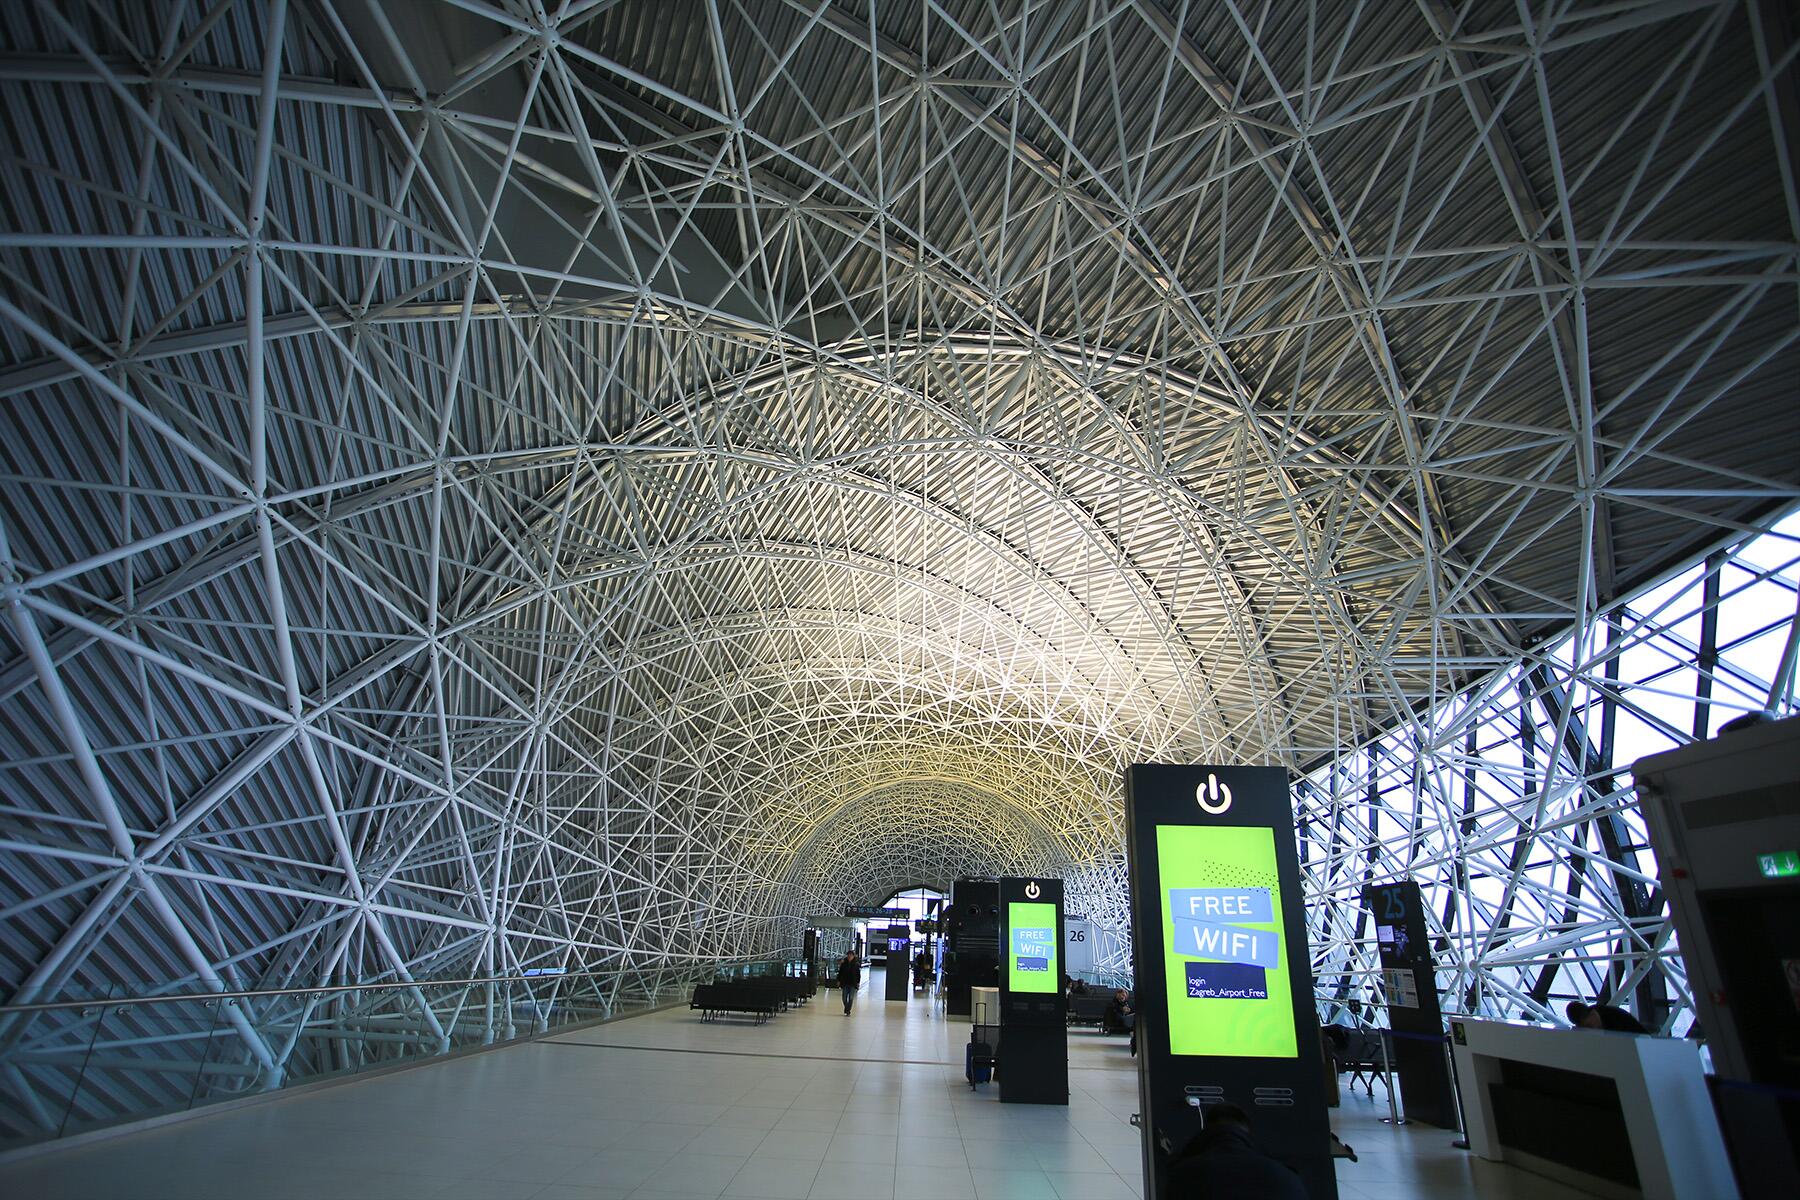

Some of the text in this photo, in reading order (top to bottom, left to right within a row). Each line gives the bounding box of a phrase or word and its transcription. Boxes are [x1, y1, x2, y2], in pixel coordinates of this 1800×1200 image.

[1189, 895, 1253, 916] FREE
[1382, 888, 1406, 919] 25
[1019, 930, 1045, 940] FREE
[1069, 930, 1085, 942] 26
[1193, 925, 1257, 961] WIFI
[1020, 943, 1047, 957] WIFI
[1188, 976, 1206, 987] login
[1189, 987, 1265, 998] Zagreb_Airport_Free
